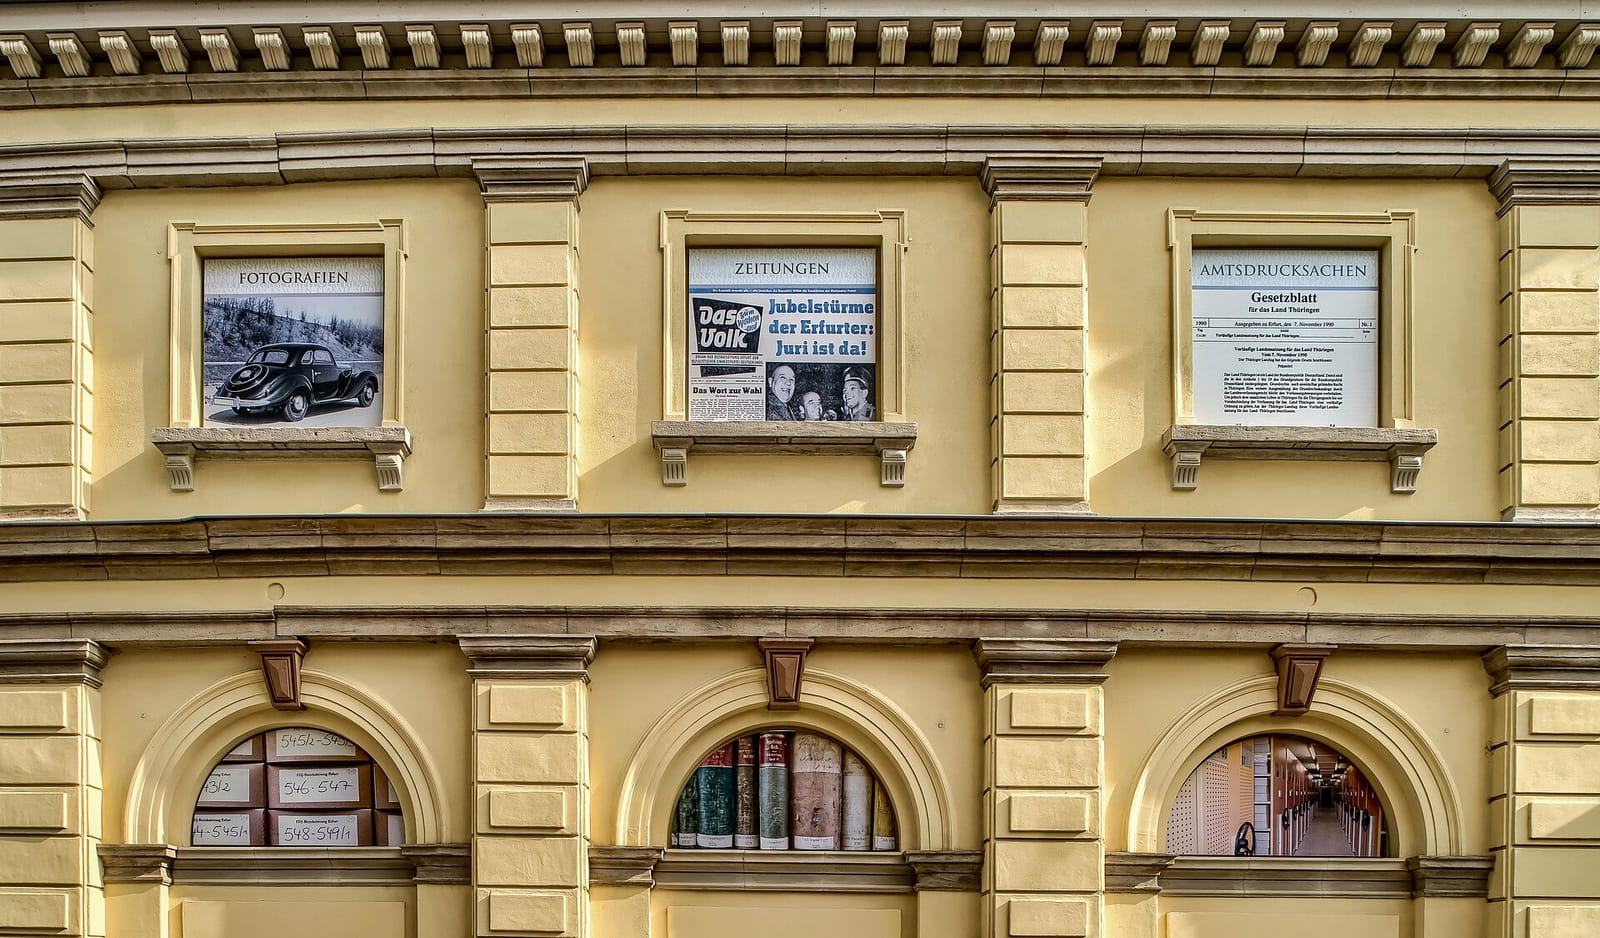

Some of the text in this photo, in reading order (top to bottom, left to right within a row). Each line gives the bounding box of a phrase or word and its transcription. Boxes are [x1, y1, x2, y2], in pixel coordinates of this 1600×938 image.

[735, 262, 830, 275] ZEITUNGEN
[1200, 264, 1367, 277] AMTSDRUCKSACHEN
[239, 271, 348, 284] FOTOGRAFIEN
[768, 298, 874, 315] Jubelstürme
[1251, 292, 1318, 304] Gesetzblatt
[699, 306, 738, 325] Das
[768, 319, 874, 336] der Erfurter:
[700, 328, 748, 348] Volk
[775, 340, 867, 357] Juri ist da!
